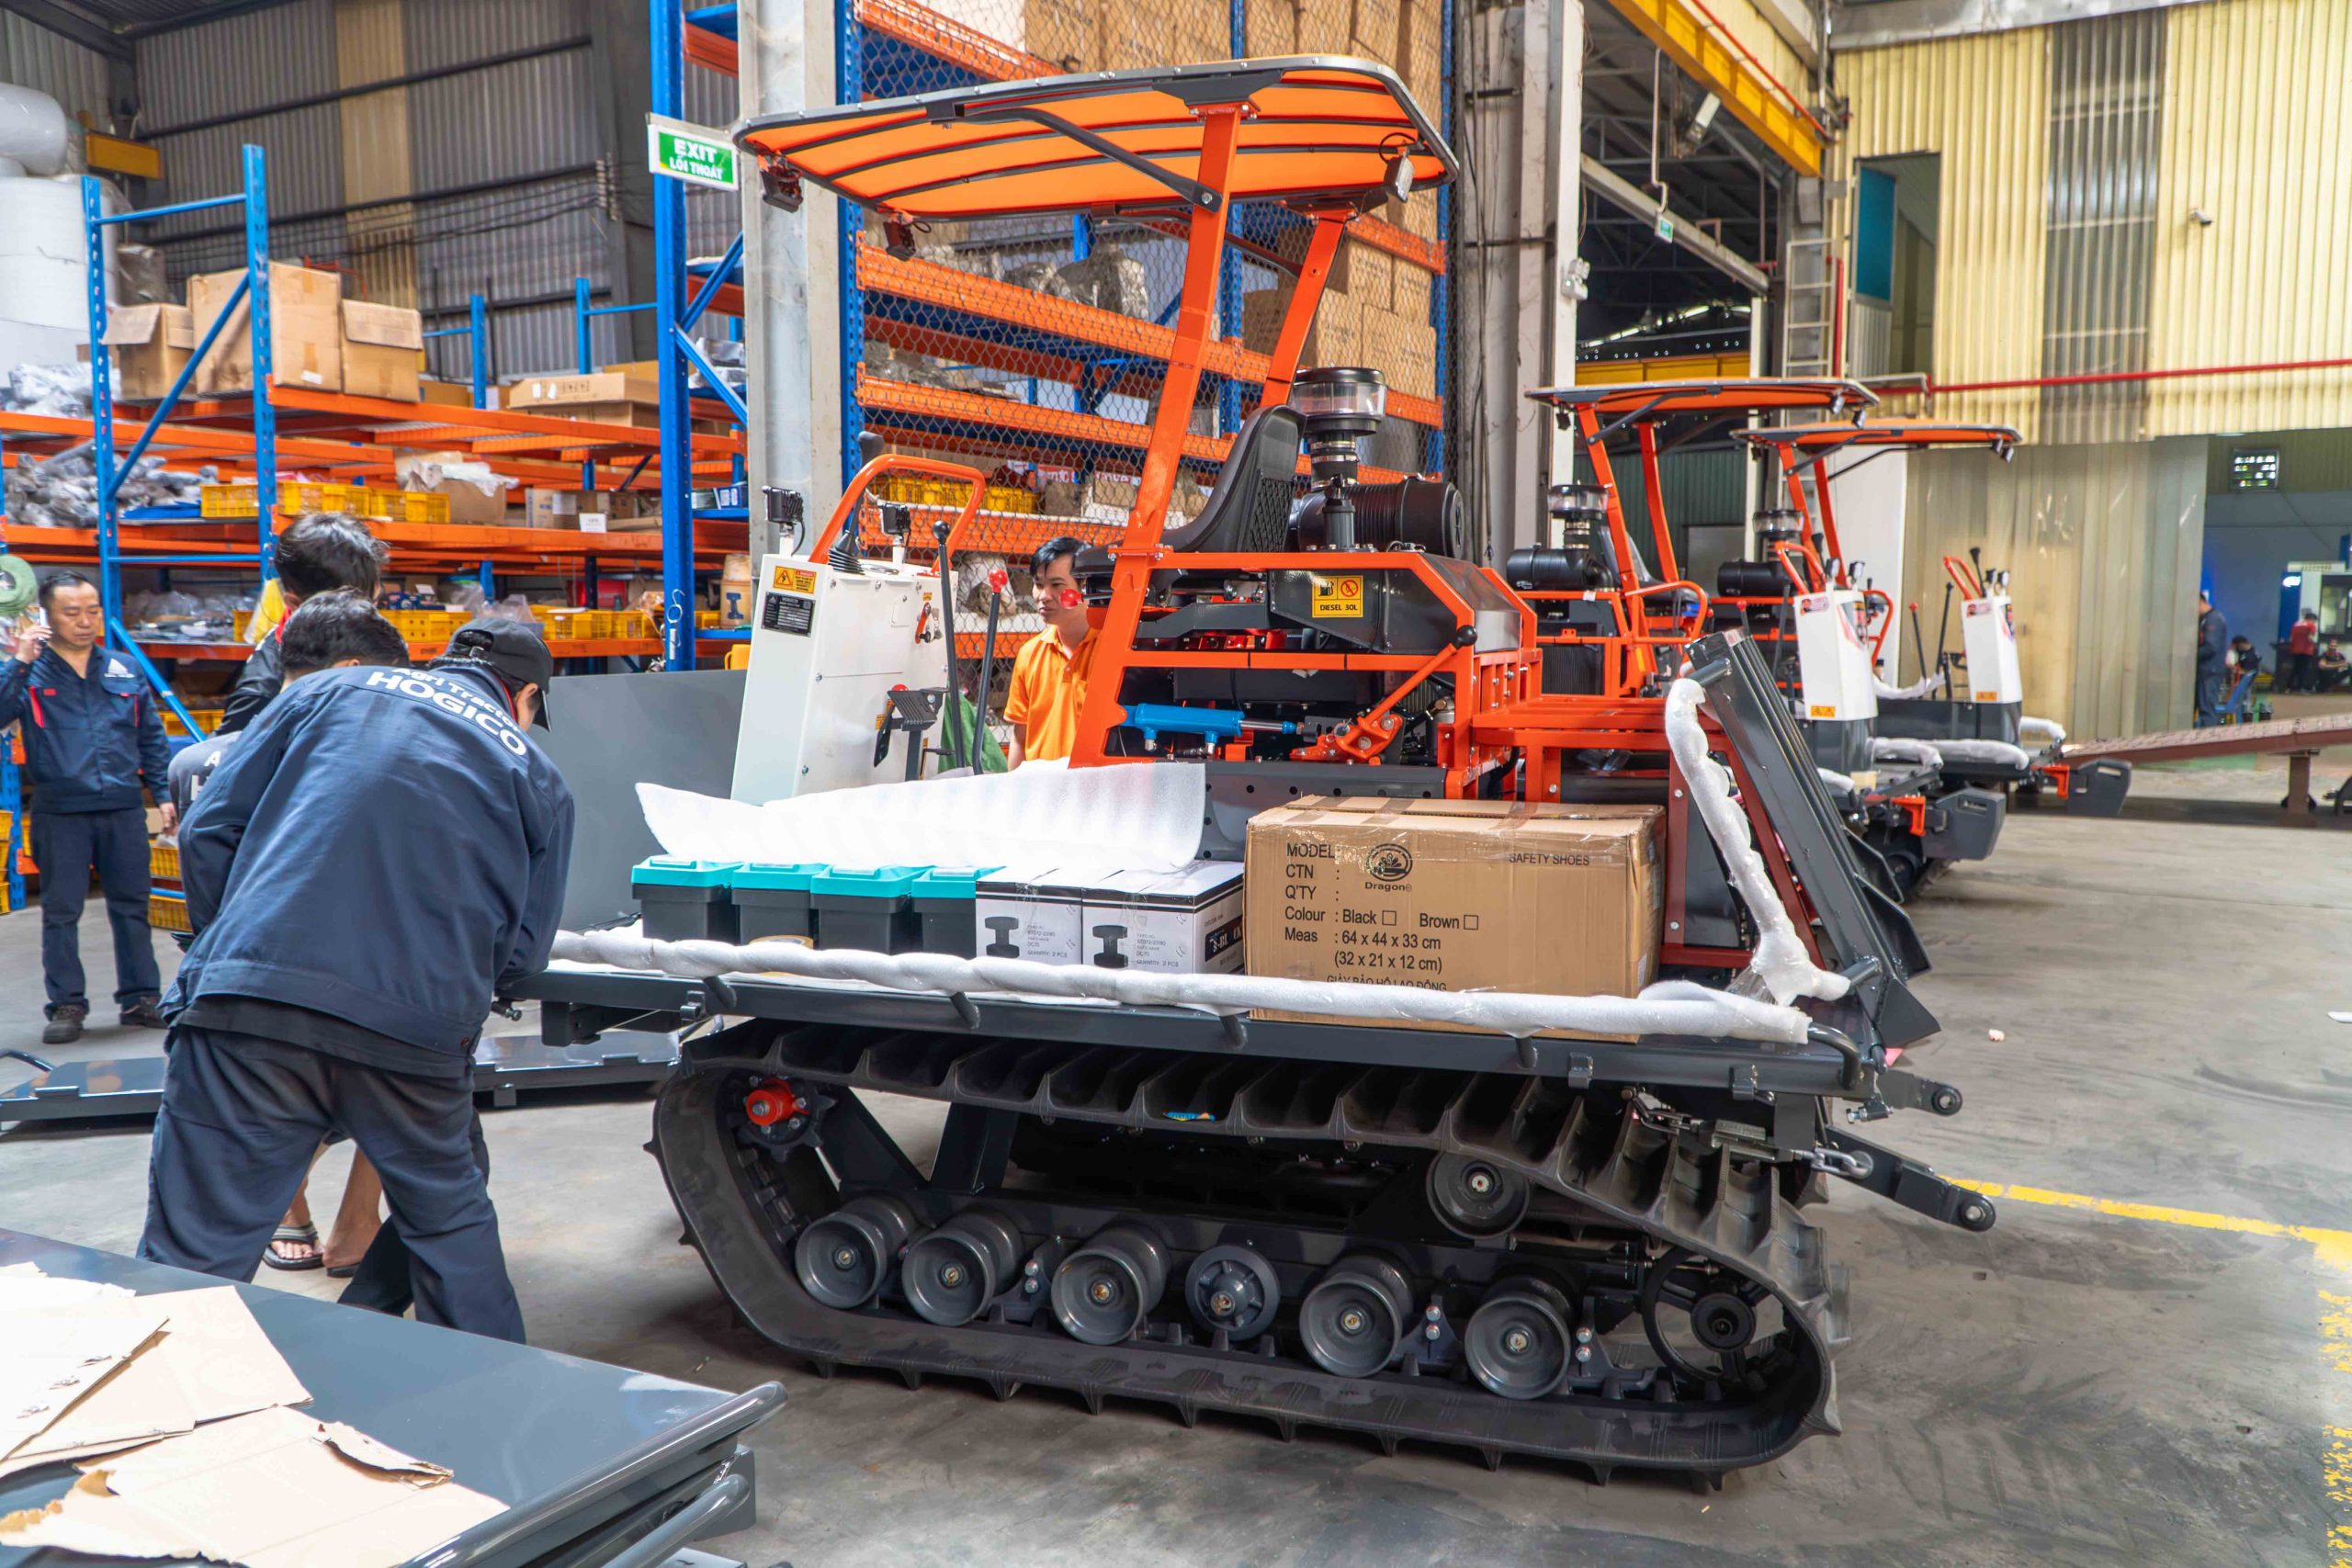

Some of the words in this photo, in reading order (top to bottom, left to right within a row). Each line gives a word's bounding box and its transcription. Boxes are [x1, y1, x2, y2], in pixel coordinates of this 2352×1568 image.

[673, 138, 718, 163] EXIT
[392, 668, 445, 687] Agri
[448, 682, 521, 733] Tractor
[366, 671, 526, 756] HOGICO
[1286, 842, 1335, 858] MODEL
[1509, 852, 1549, 864] SAFETY
[1553, 854, 1589, 866] SHOES
[1286, 863, 1314, 879] CTN
[1285, 885, 1317, 900] Q'TY
[1284, 906, 1326, 922] Colour
[1342, 908, 1377, 925] Black
[1419, 912, 1460, 930] Brown
[1284, 927, 1318, 942] Meas
[1341, 930, 1357, 945] 64
[1361, 934, 1369, 946] x
[1372, 931, 1387, 947] 44
[1391, 936, 1399, 948] x
[1402, 933, 1418, 949] 33
[1421, 937, 1442, 950] cm
[1334, 950, 1353, 968] (32
[1358, 954, 1366, 966] x
[1369, 953, 1384, 967] 21
[1387, 957, 1396, 969] x
[1399, 954, 1415, 970] 12
[1418, 958, 1442, 975] cm)
